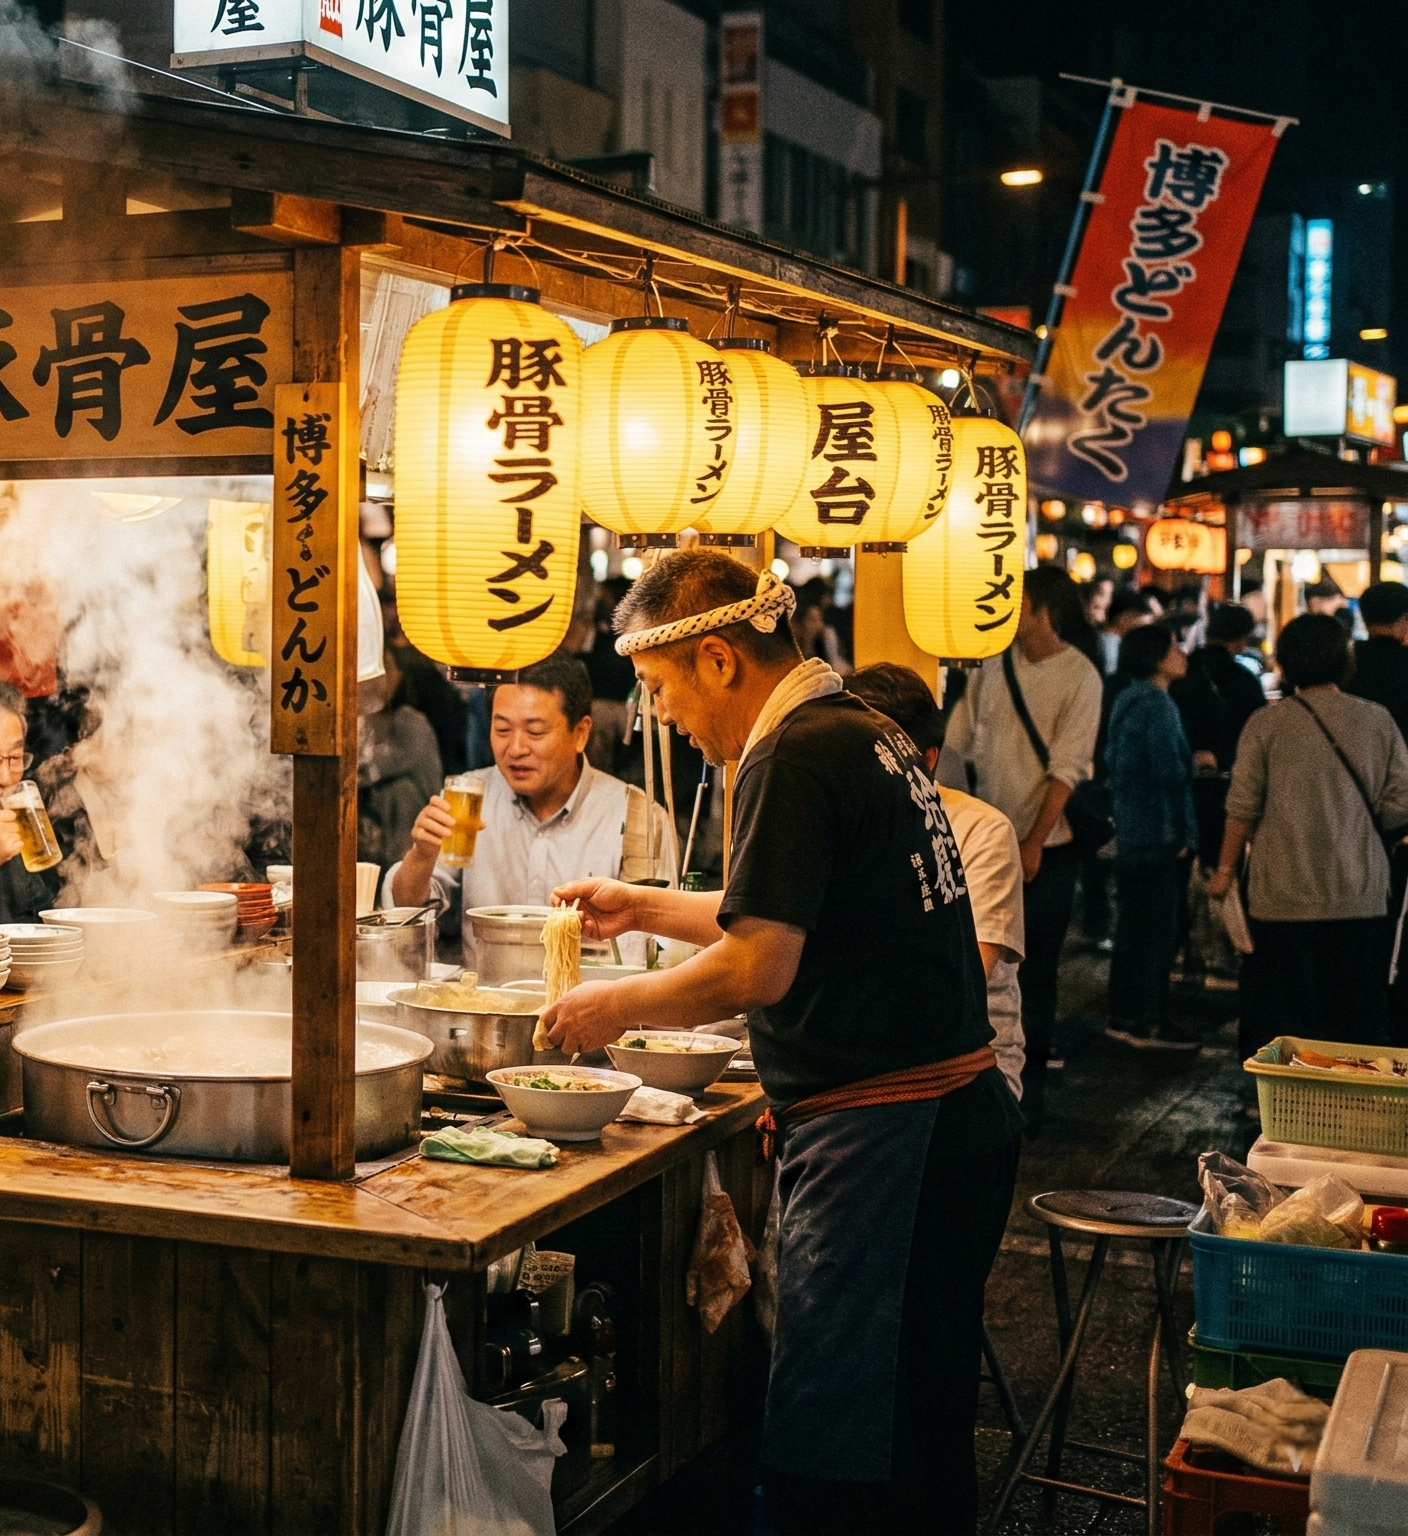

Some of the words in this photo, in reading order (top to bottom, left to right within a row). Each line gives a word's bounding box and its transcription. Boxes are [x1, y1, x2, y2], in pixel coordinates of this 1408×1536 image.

[1067, 139, 1229, 483] 博多どんたく
[485, 337, 568, 632] 豚骨ラーメン
[690, 360, 733, 504] 豚骨ラーメン
[810, 401, 877, 525] 屋台
[974, 445, 1021, 632] 豚骨ラーメン
